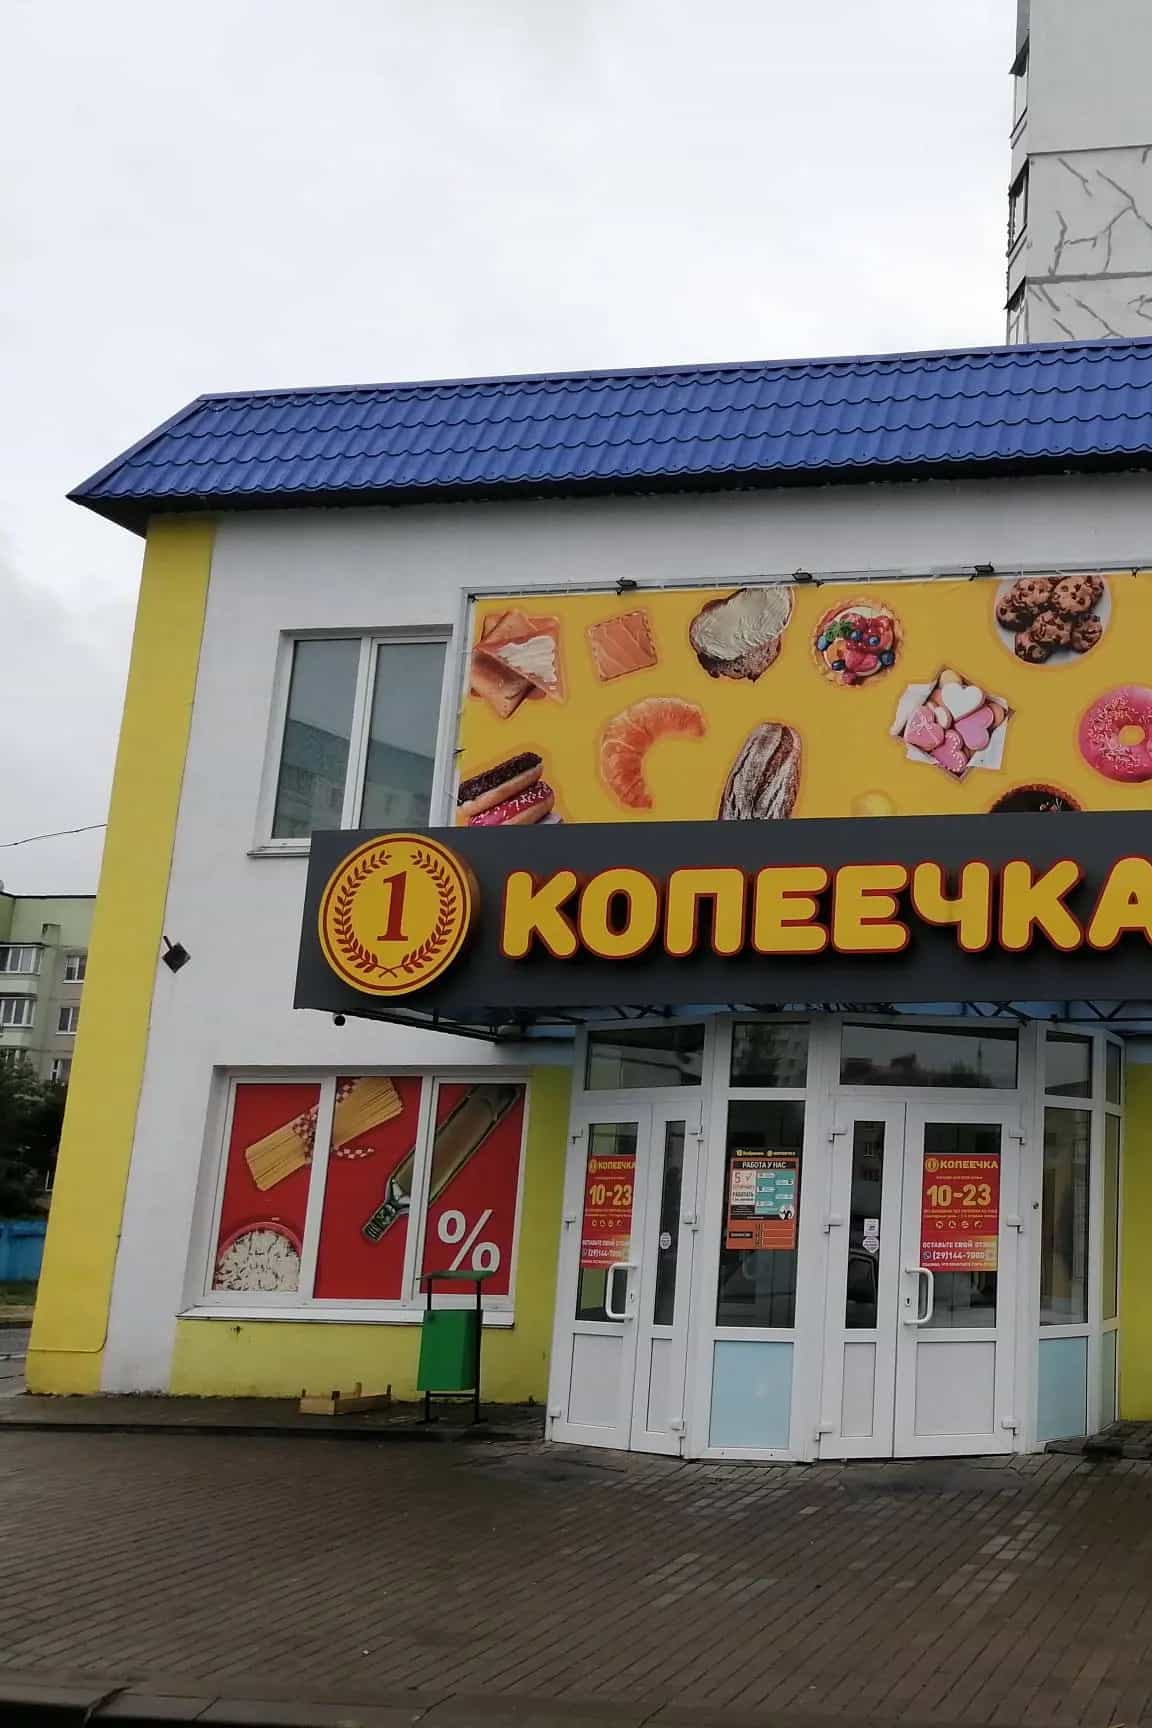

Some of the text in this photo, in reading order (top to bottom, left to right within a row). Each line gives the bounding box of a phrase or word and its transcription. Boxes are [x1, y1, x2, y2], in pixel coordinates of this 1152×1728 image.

[376, 870, 409, 941] 1
[599, 1161, 635, 1169] КОПЕЕЧКА
[940, 1160, 998, 1169] КОПЕЕЧКА
[589, 1184, 632, 1206] 10-23
[927, 1184, 992, 1207] 10-23
